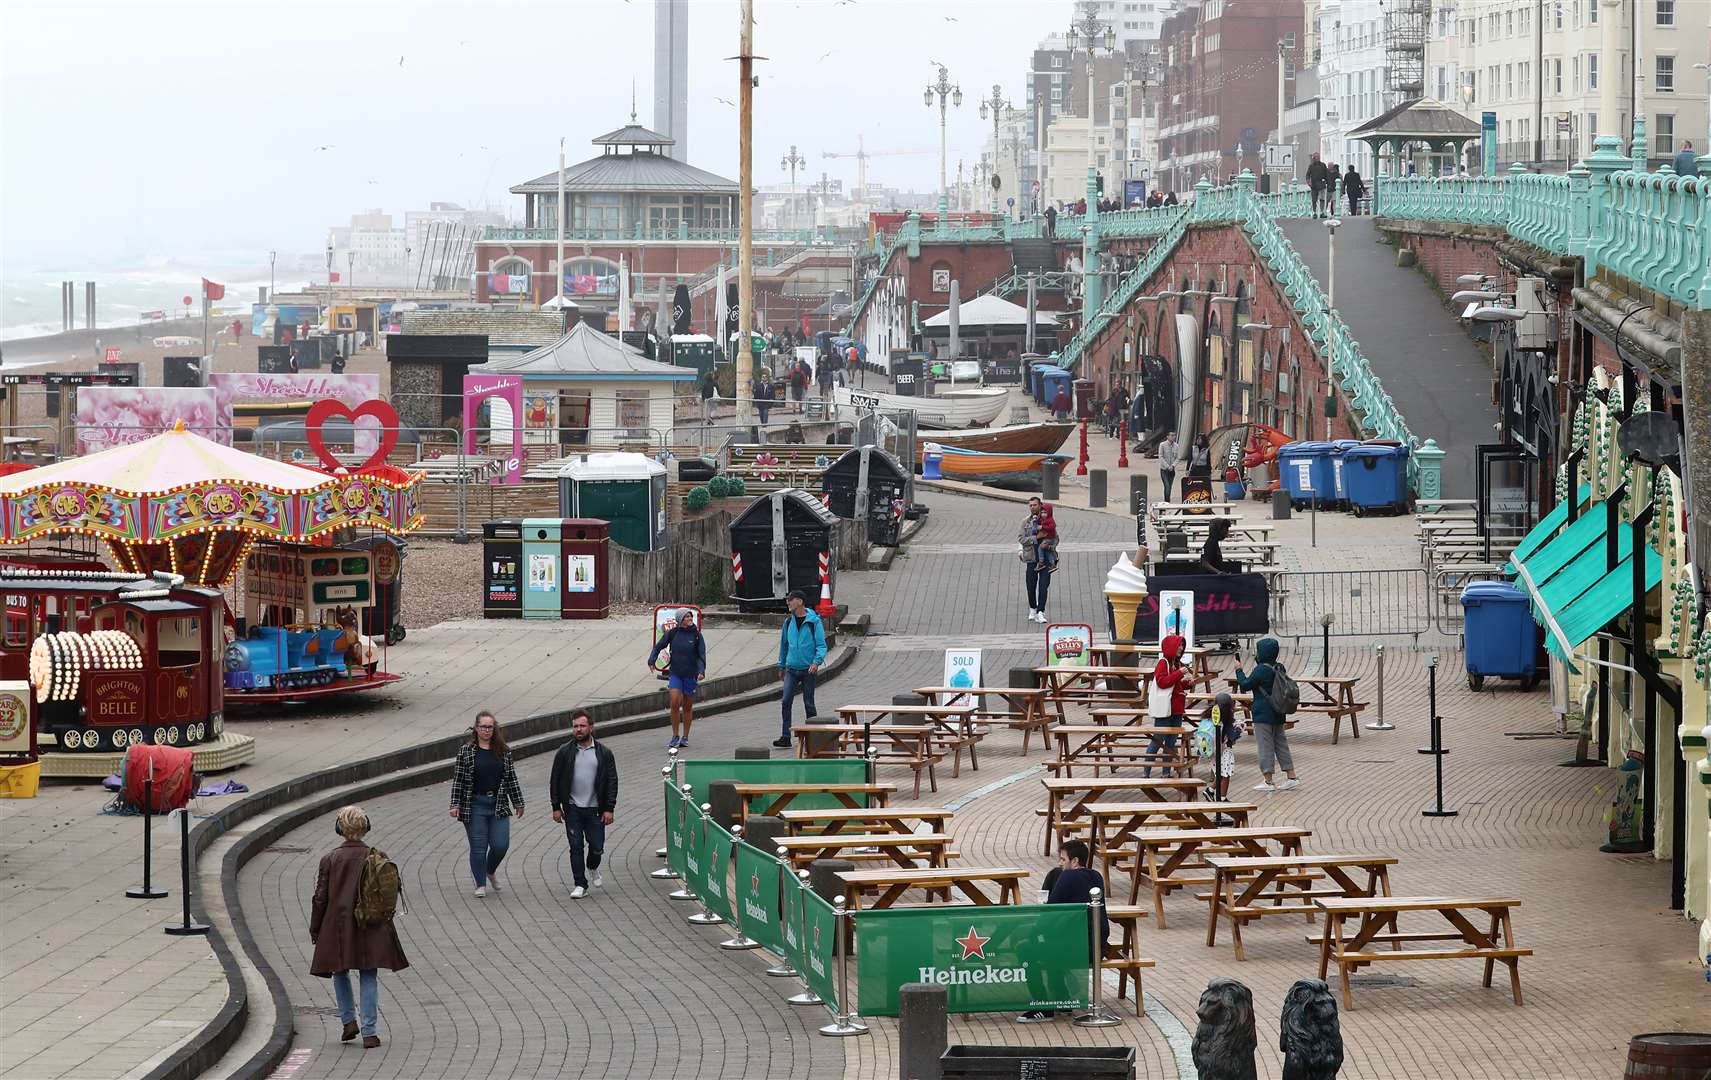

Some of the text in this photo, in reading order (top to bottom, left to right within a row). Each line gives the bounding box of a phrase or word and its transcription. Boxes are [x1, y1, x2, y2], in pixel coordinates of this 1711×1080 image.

[897, 374, 915, 383] BEER
[1227, 440, 1241, 467] SM85
[6, 595, 27, 608] BUS TO
[953, 657, 974, 666] SOLD
[96, 680, 141, 696] BRIGHTON
[100, 702, 137, 715] BELLE
[919, 964, 1028, 985] Heineken
